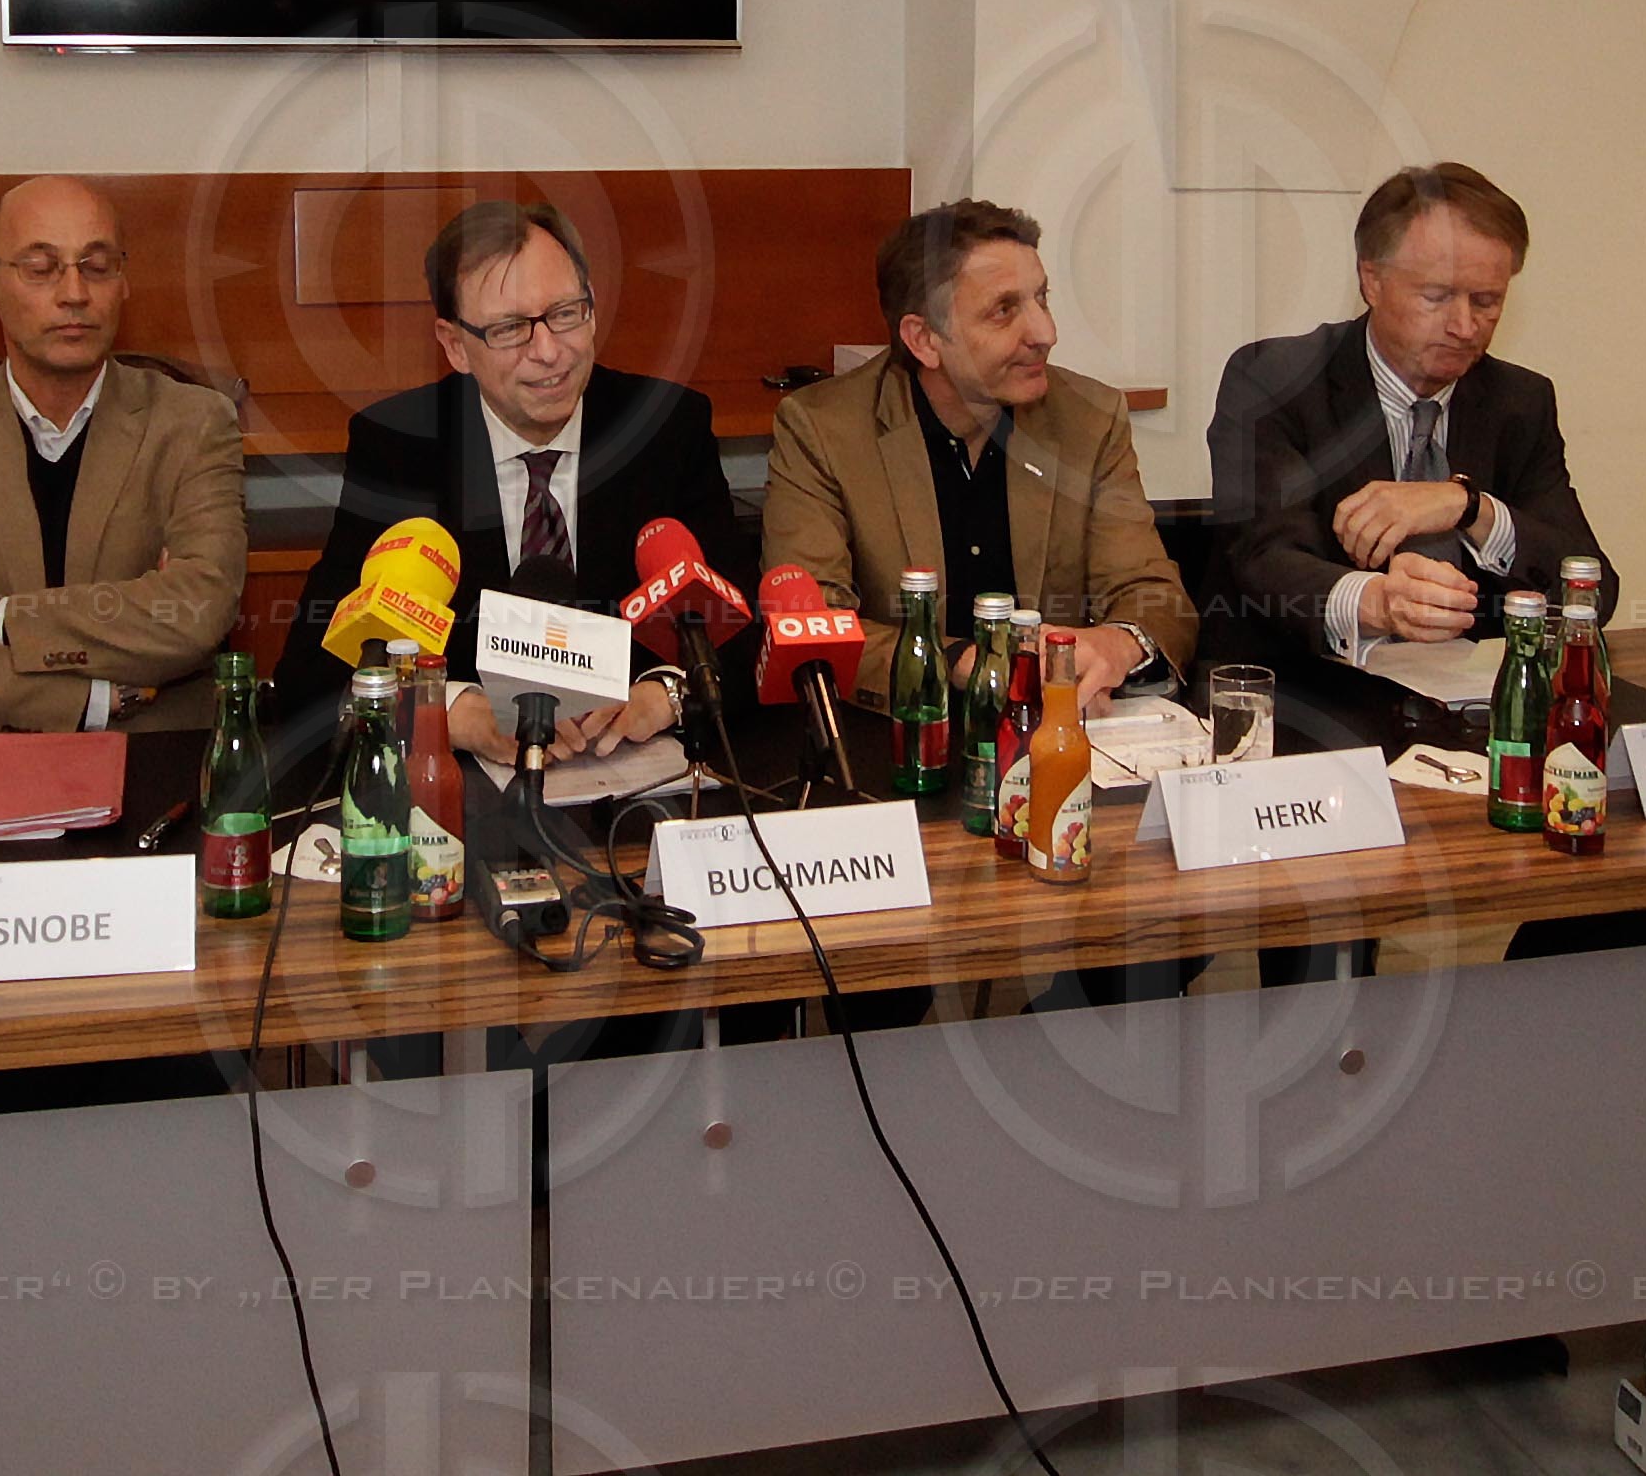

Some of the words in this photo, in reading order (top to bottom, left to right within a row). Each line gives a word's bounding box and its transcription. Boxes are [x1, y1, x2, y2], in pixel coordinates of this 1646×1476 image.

[625, 561, 687, 619] ORF
[693, 561, 744, 605] ORF
[771, 571, 803, 586] ORF
[777, 615, 853, 637] ORF
[490, 635, 594, 670] SOUNDPORTAL
[1255, 800, 1327, 830] HERK
[708, 853, 895, 896] BUCHMANN
